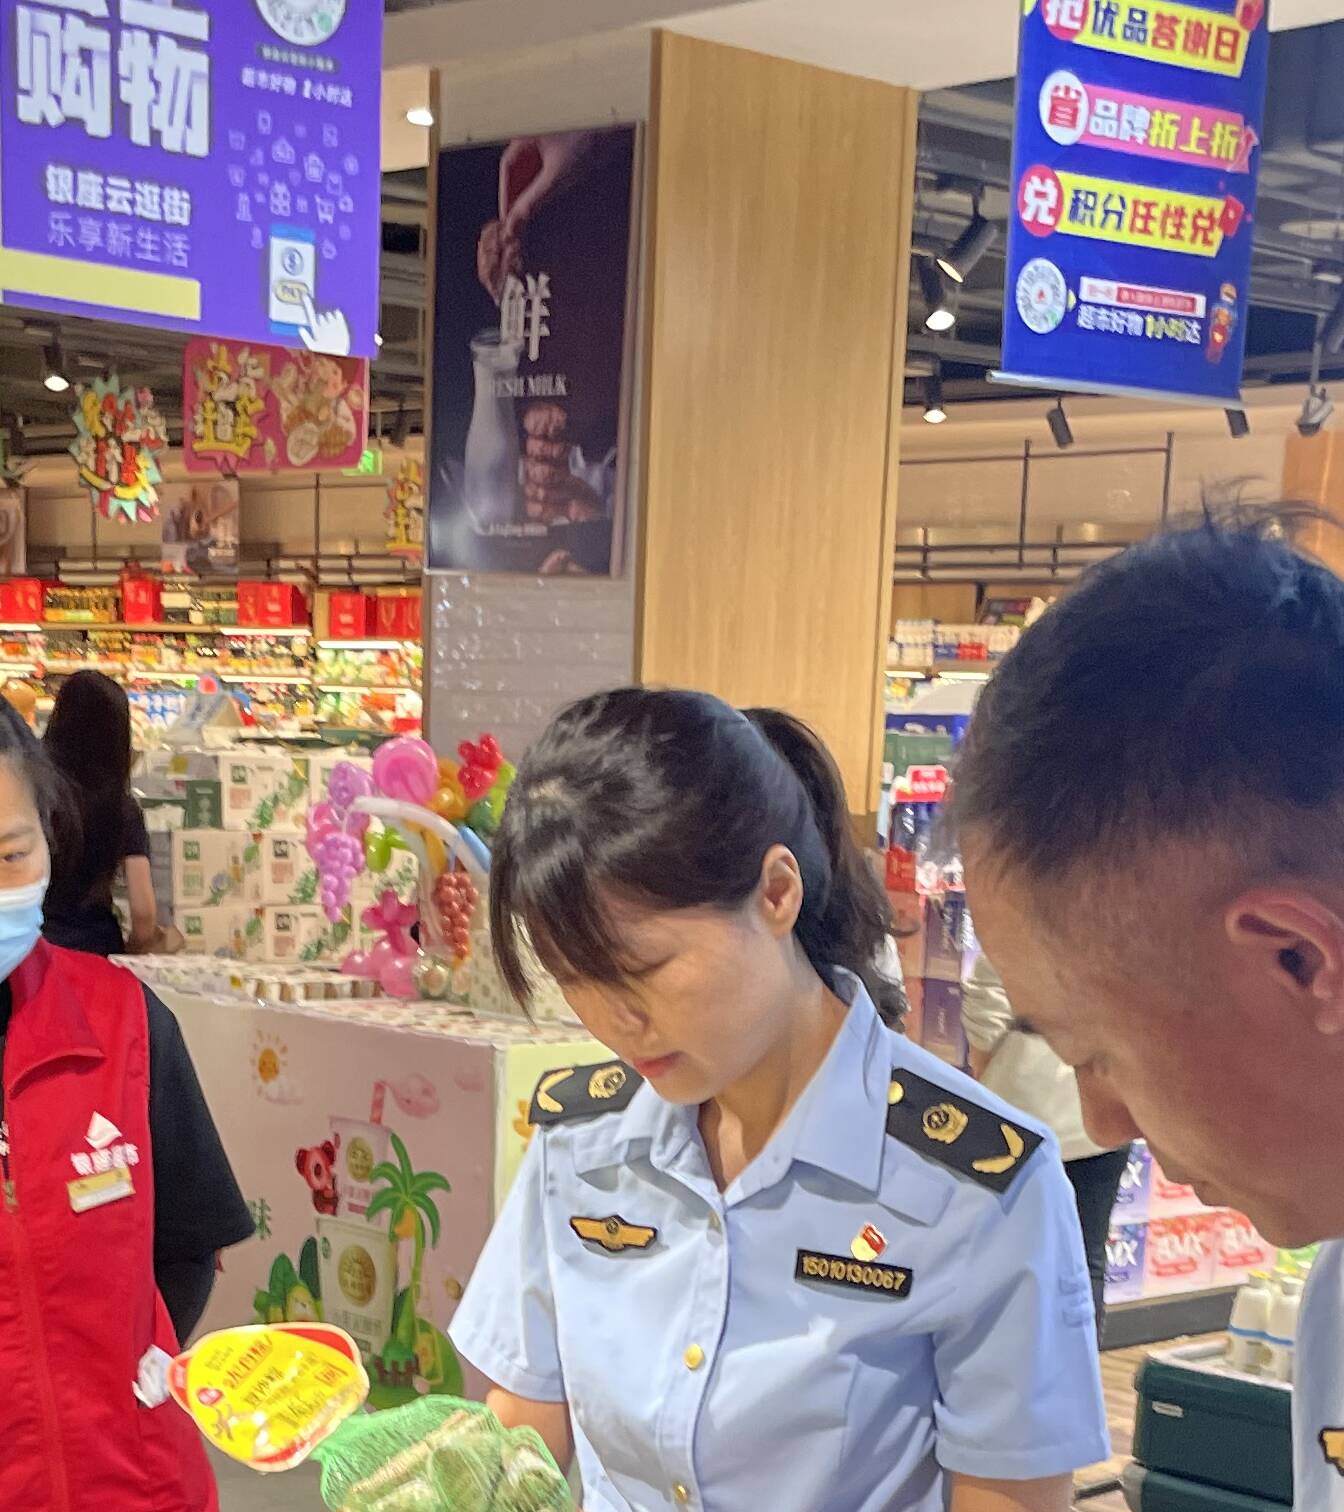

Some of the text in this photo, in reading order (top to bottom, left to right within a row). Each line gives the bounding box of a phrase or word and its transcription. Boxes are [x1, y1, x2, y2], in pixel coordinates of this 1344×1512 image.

[1092, 0, 1242, 65] 优品答谢日
[14, 3, 210, 159] 购物
[1088, 98, 1242, 161] 品牌折上折
[45, 163, 192, 228] 银座云逛街
[1022, 175, 1217, 247] 兑 积分任性兑
[47, 210, 192, 269] 乐享新生活
[499, 271, 552, 362] 鲜
[802, 1255, 907, 1291] 15010130067
